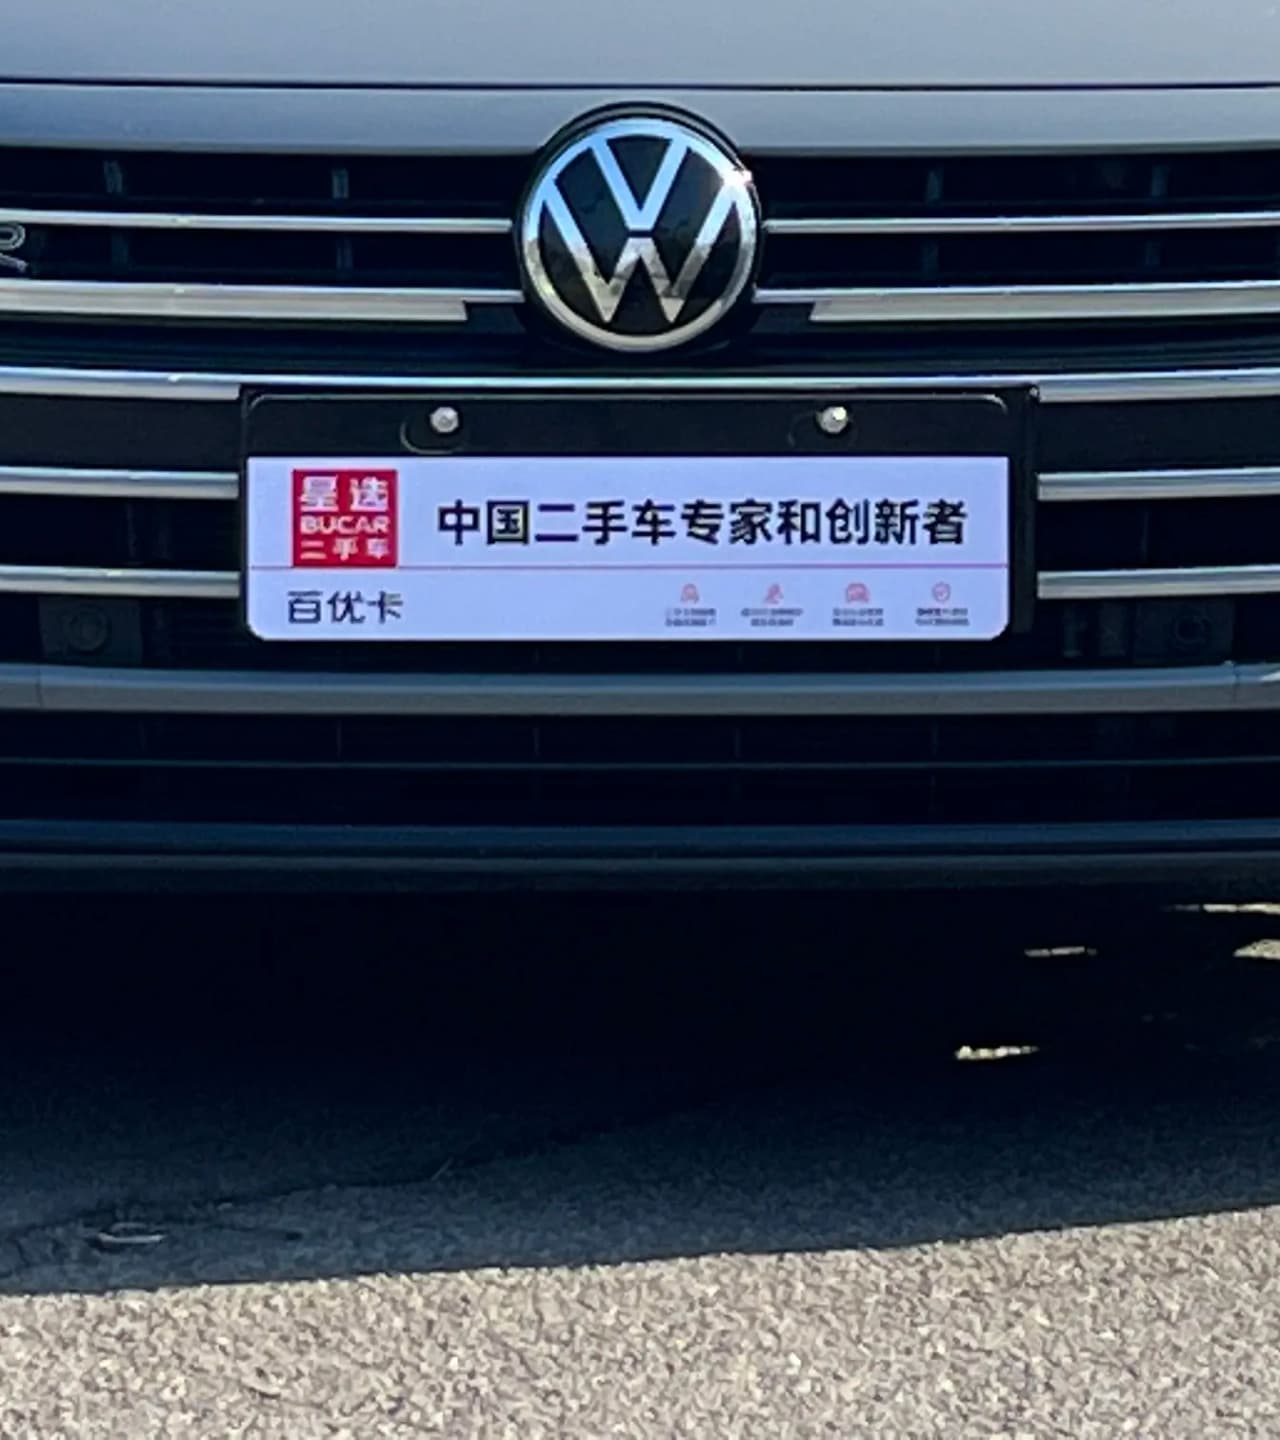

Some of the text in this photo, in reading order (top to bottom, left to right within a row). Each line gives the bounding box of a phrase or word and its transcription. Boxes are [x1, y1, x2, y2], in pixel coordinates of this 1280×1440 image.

[299, 515, 390, 536] BUCAR
[437, 498, 968, 546] 中国二手车专家和创新者
[299, 536, 390, 562] 二手车
[287, 589, 404, 625] 百优卡
